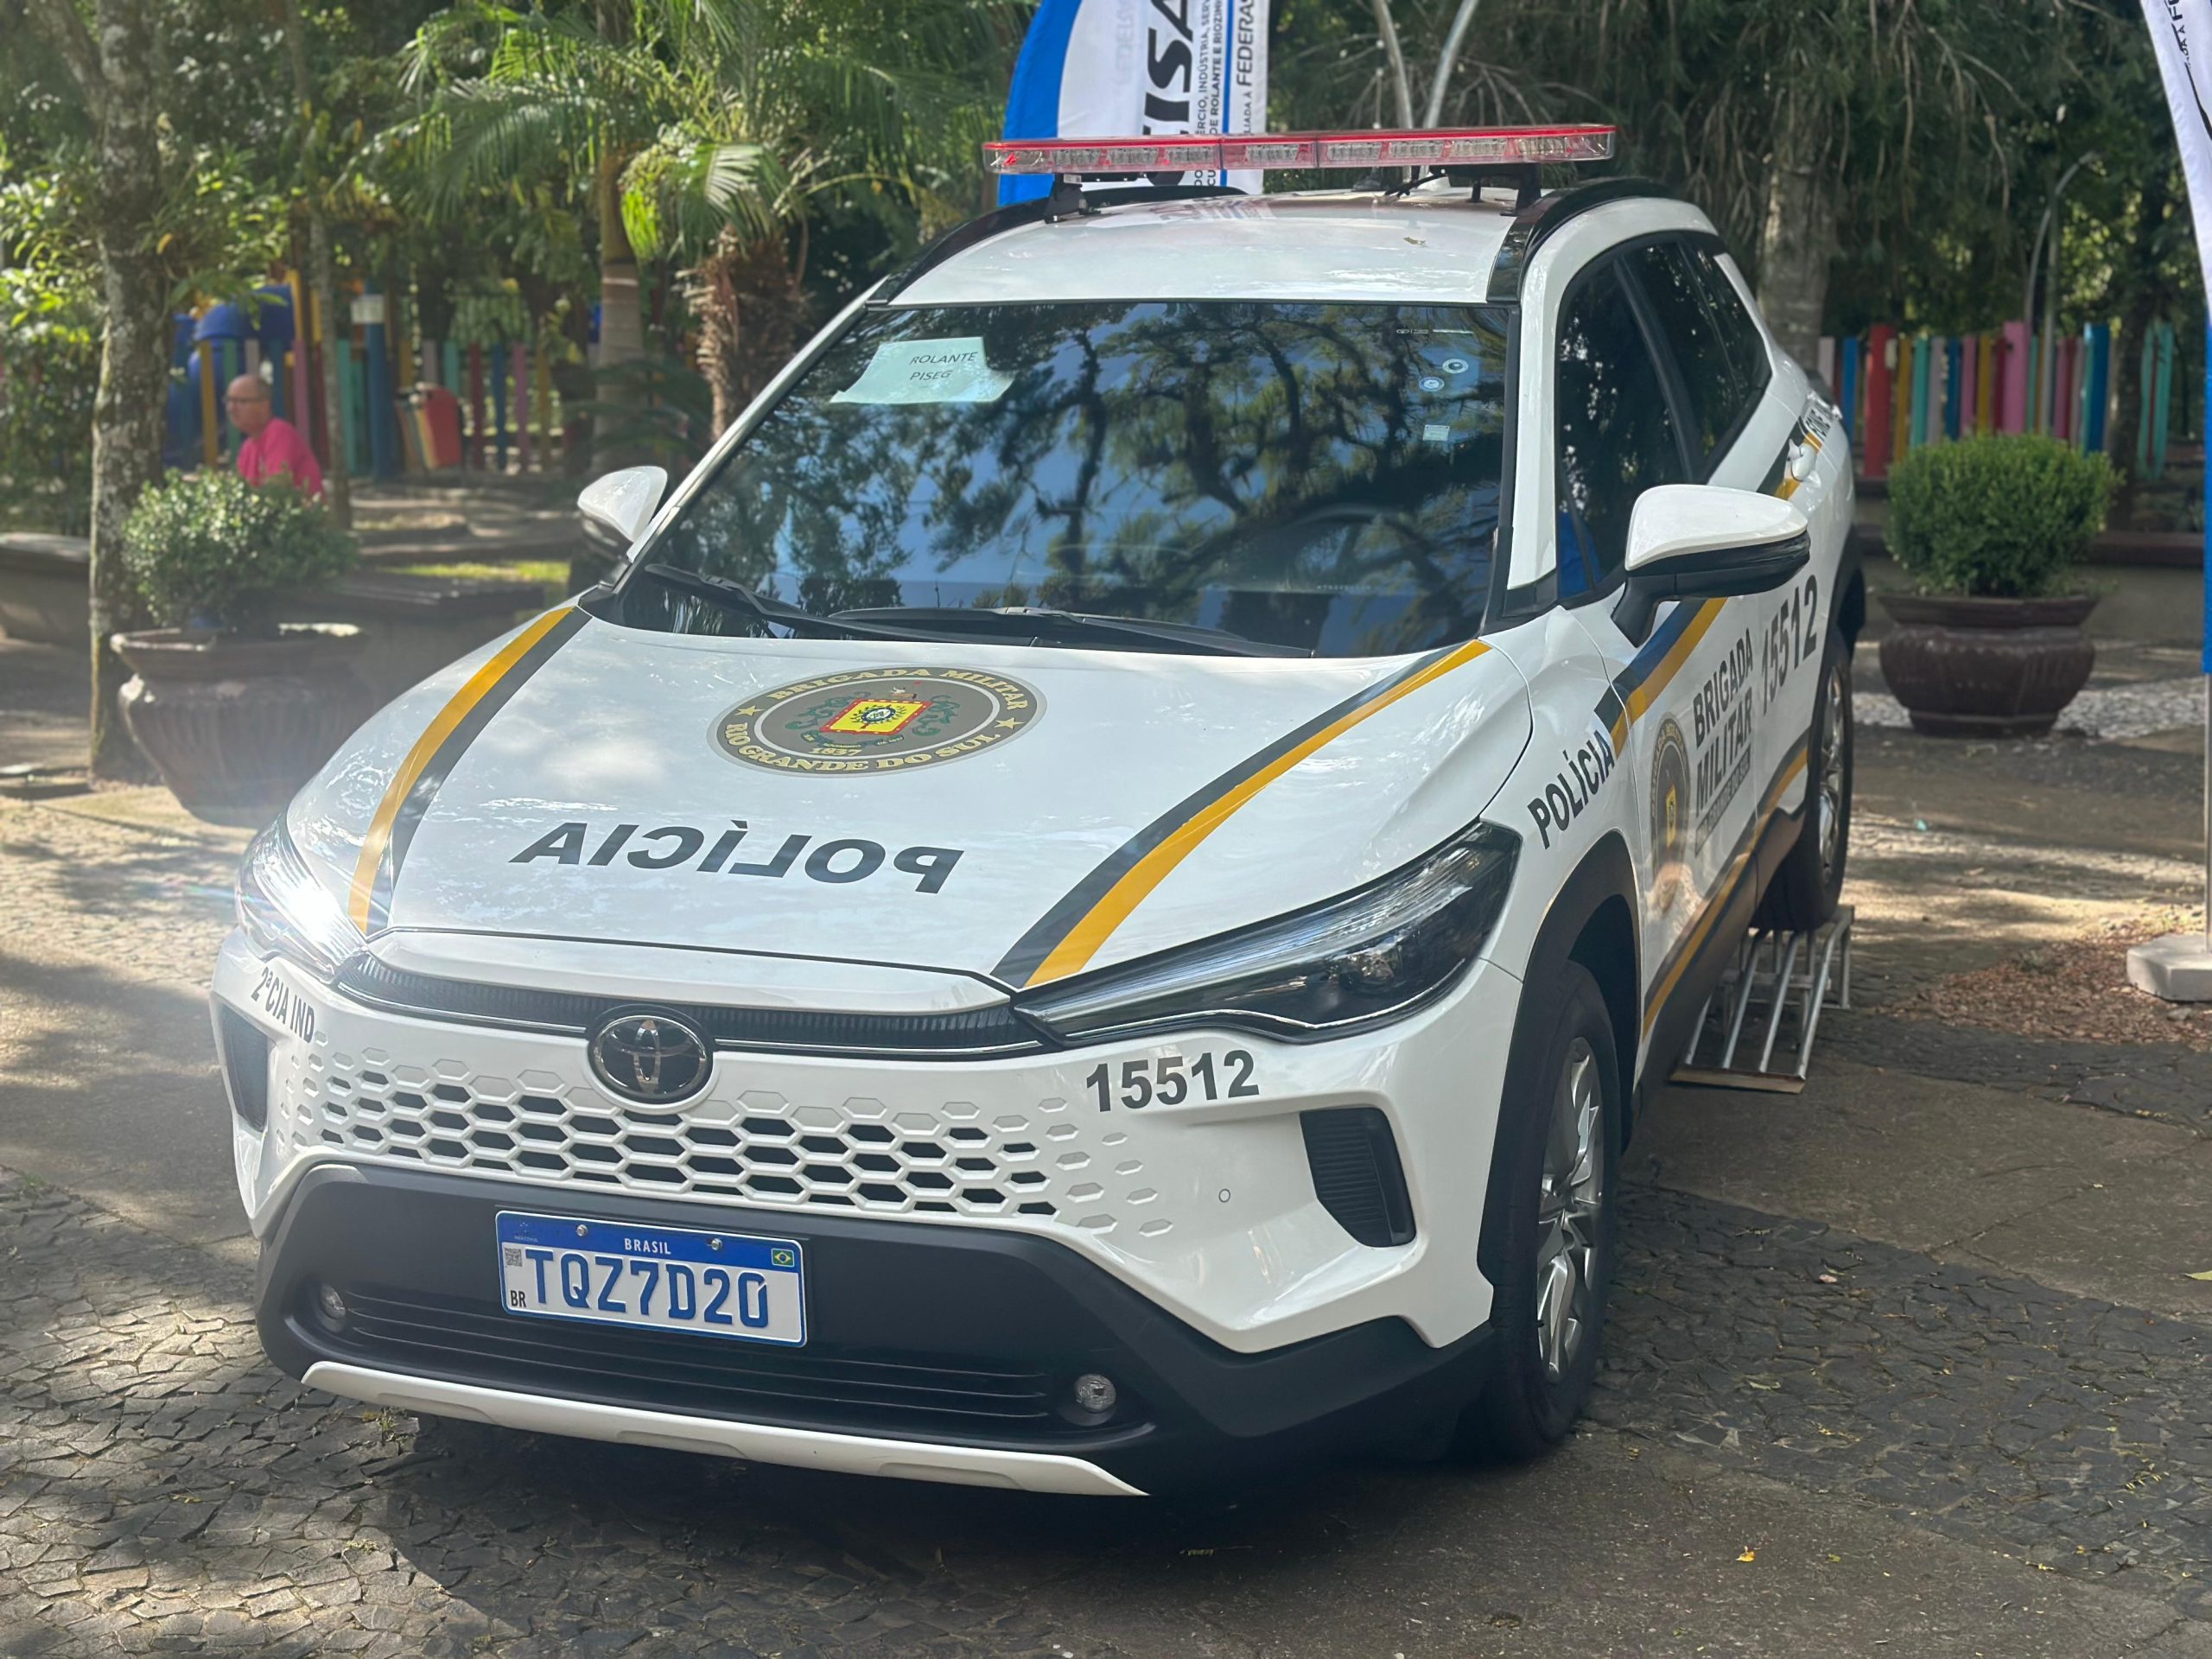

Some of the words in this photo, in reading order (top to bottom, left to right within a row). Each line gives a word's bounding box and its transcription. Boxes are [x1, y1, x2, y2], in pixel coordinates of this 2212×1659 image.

[1236, 0, 1255, 86] FEDERA
[1211, 57, 1222, 115] ROLANTE
[1243, 101, 1252, 133] LIADA
[909, 352, 978, 365] ROLANTE
[1762, 575, 1818, 716] 15512
[766, 669, 931, 700] BRIGADA
[940, 670, 1028, 710] MILITAR
[1693, 627, 1753, 750] BRIGADA
[726, 722, 750, 746] RIO
[738, 745, 869, 771] GRANDE
[876, 753, 931, 769] DO
[935, 734, 1001, 758] SUL
[1696, 686, 1752, 818] MILITAR
[1527, 729, 1615, 849] POLÍCIA
[290, 995, 315, 1043] IND
[1086, 1049, 1260, 1112] 15512
[624, 1237, 671, 1255] BRASIL
[510, 1289, 526, 1308] BR
[524, 1247, 770, 1328] TQZ7D20
